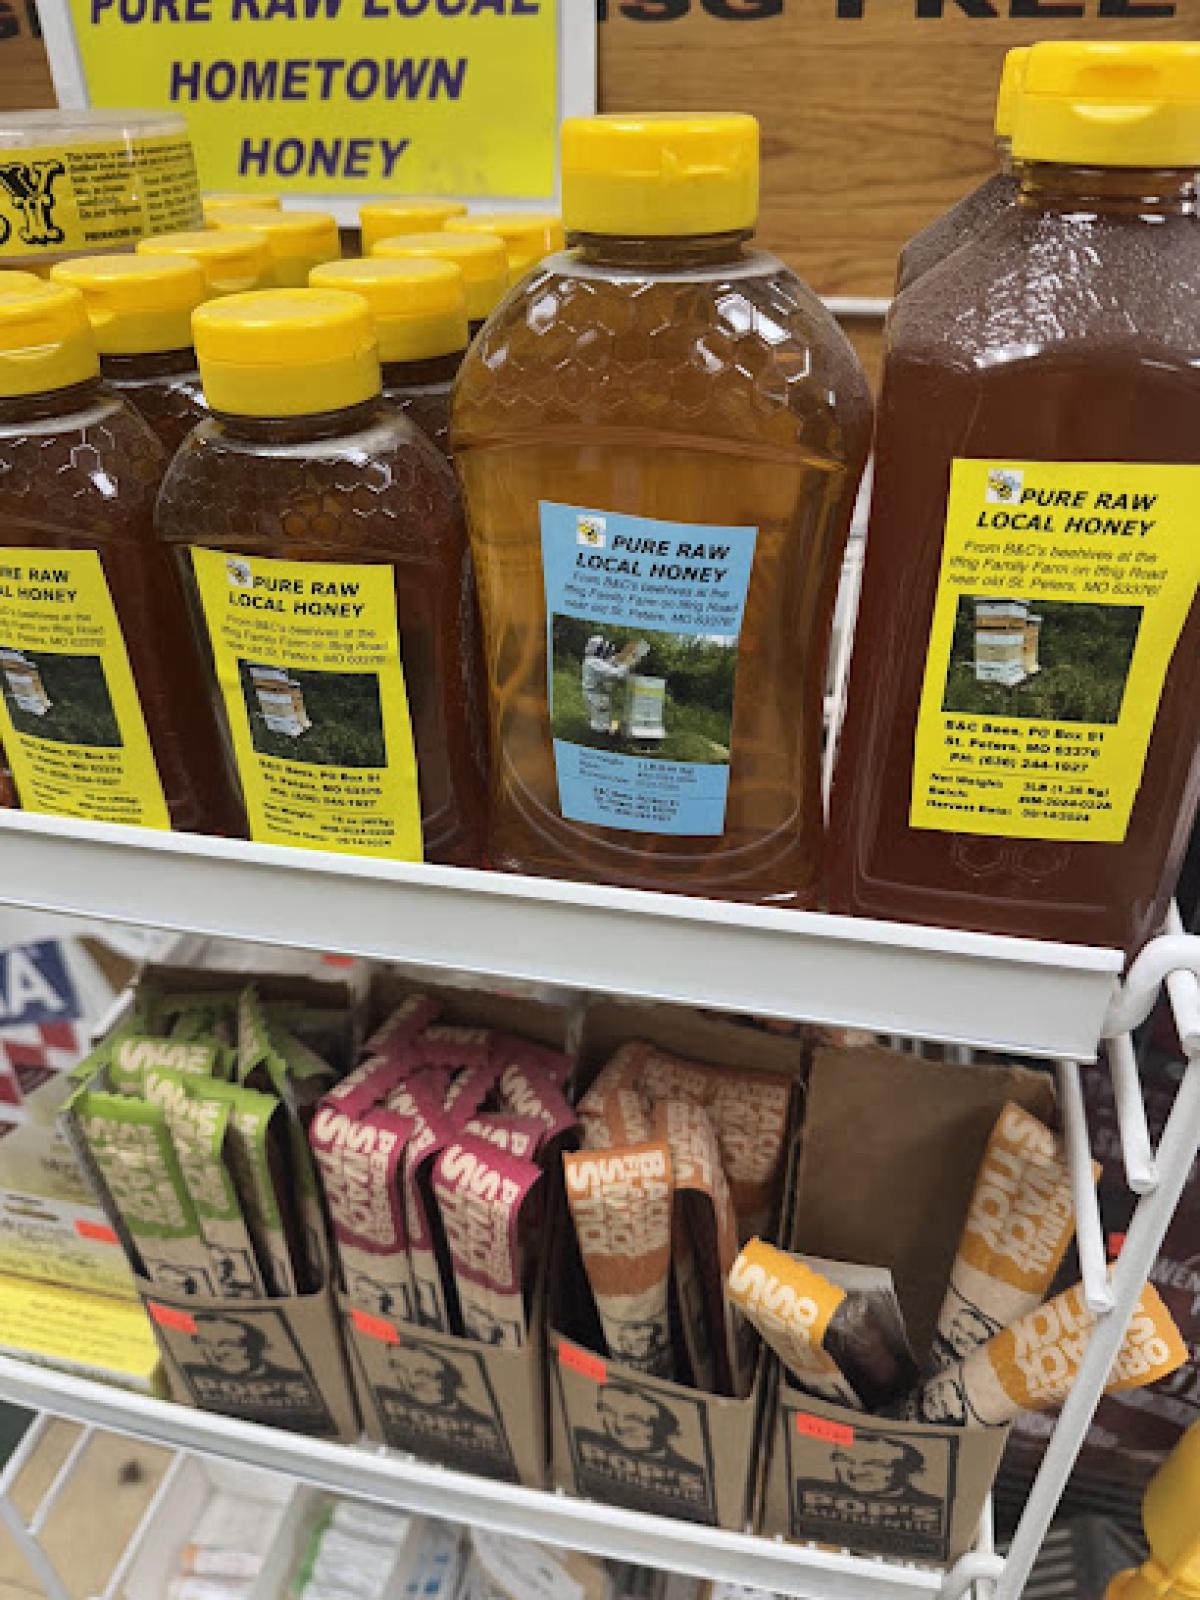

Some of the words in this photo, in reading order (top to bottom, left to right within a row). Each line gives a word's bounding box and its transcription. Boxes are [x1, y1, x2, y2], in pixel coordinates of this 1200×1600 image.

[90, 0, 198, 25] PURE
[230, 0, 353, 22] RAW
[169, 58, 468, 101] HOMETOWN
[238, 138, 410, 178] HONEY
[1020, 487, 1088, 509] PURE
[1094, 493, 1159, 513] RAW
[976, 511, 1055, 533] LOCAL
[1064, 516, 1156, 537] HONEY
[611, 534, 672, 557] PURE
[676, 541, 731, 560] RAW
[28, 569, 71, 583] RAW
[575, 552, 642, 577] LOCAL
[649, 563, 728, 583] HONEY
[17, 587, 77, 603] HONEY
[252, 575, 304, 595] PURE
[311, 581, 360, 597] RAW
[228, 590, 286, 612] LOCAL
[293, 602, 365, 618] HONEY
